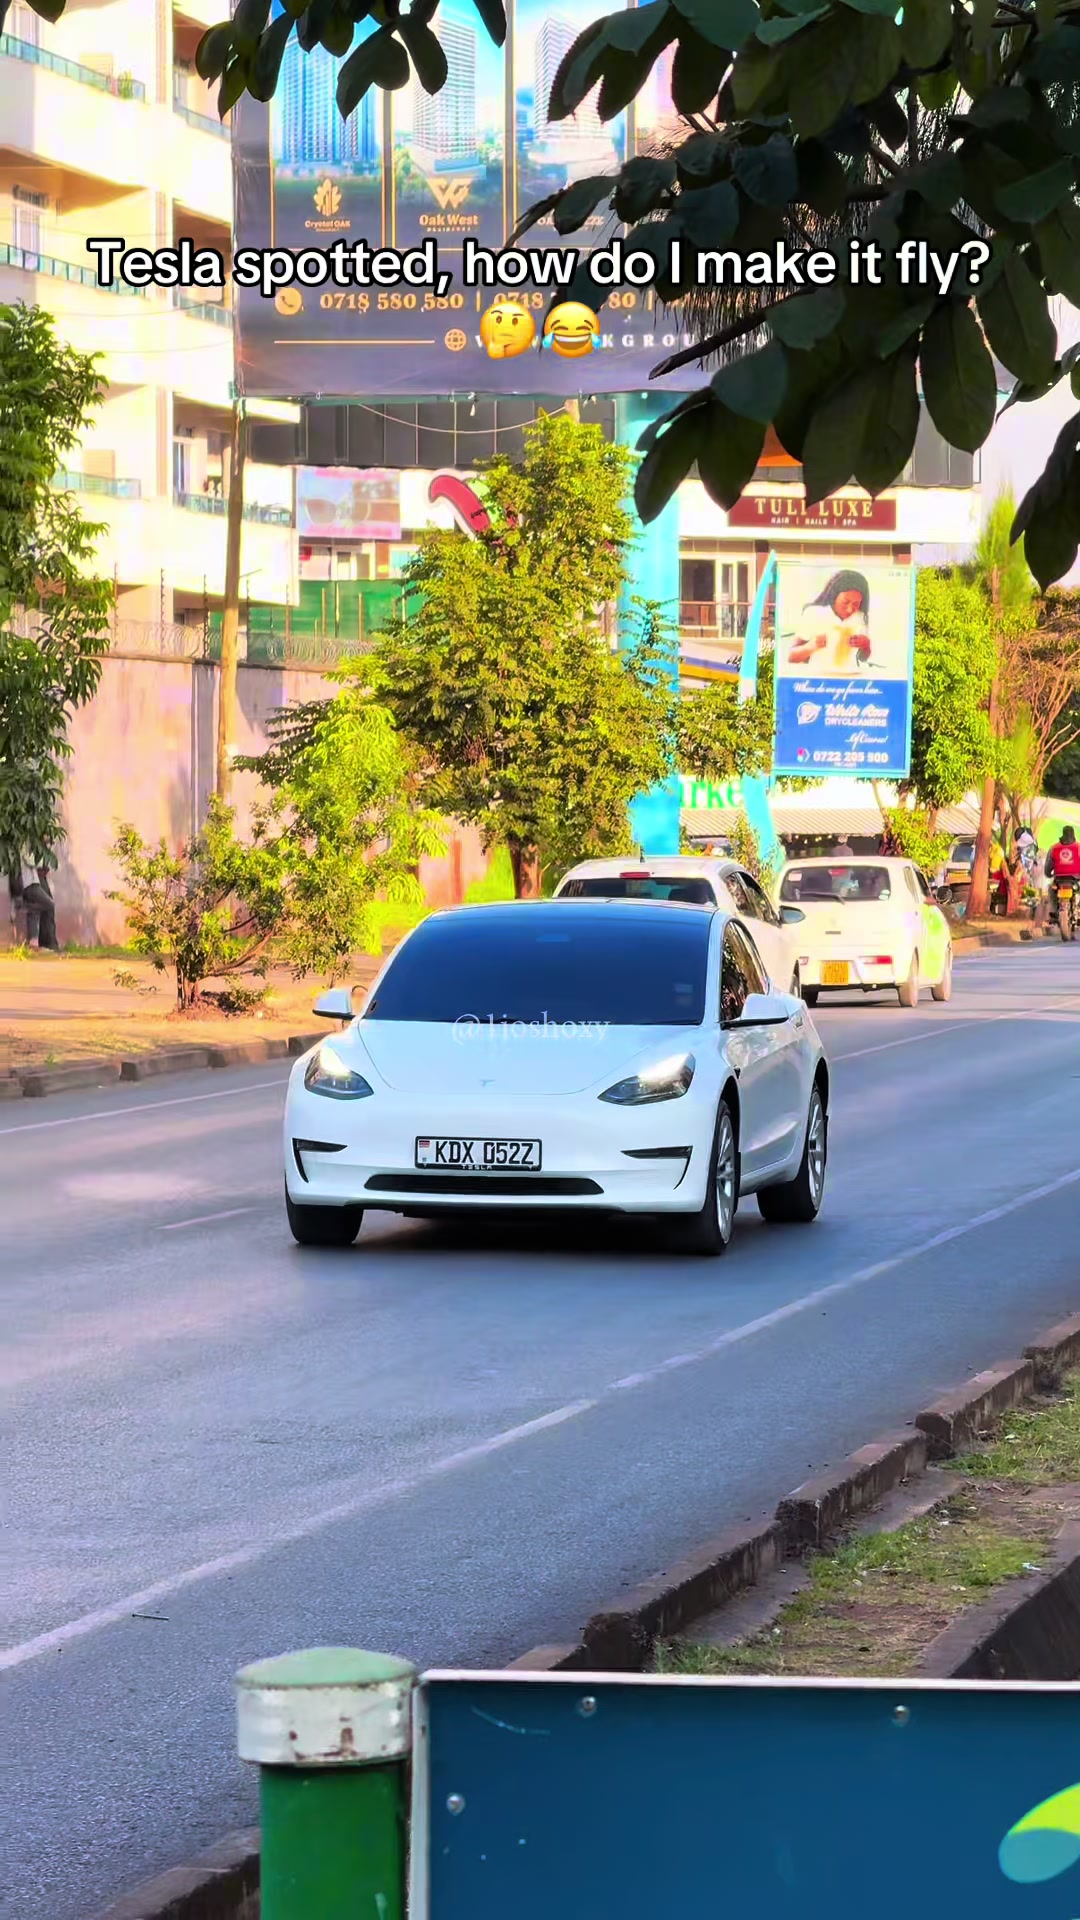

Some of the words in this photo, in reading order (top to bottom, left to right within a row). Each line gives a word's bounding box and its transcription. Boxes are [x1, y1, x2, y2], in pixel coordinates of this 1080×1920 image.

[419, 214, 445, 226] Oak
[447, 214, 479, 226] West
[319, 292, 370, 311] 0718
[377, 292, 417, 310] 580
[818, 500, 873, 518] LUXE
[813, 751, 842, 762] 0722
[435, 1140, 474, 1163] KDX
[483, 1141, 534, 1165] 052Z
